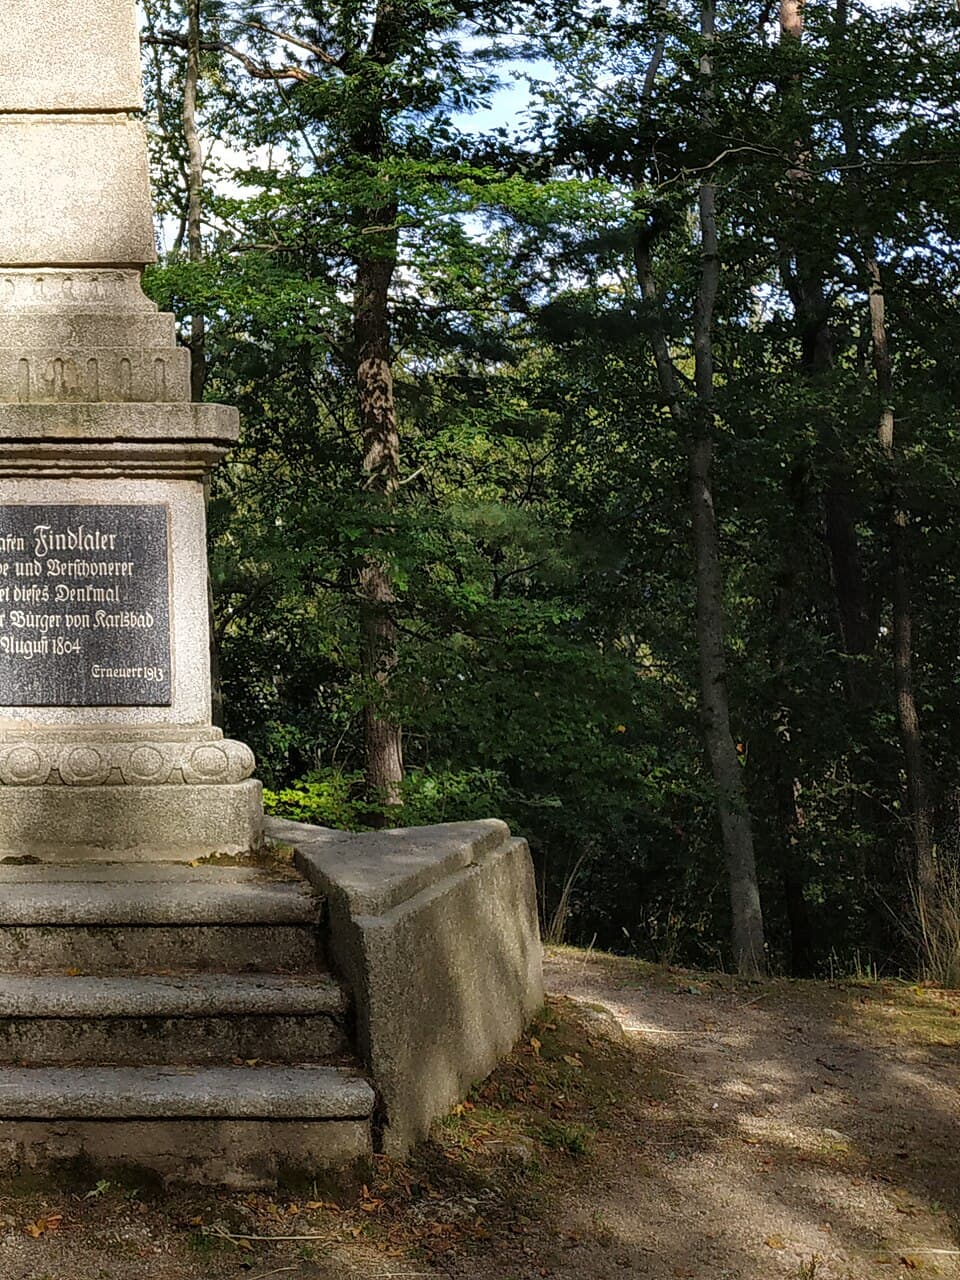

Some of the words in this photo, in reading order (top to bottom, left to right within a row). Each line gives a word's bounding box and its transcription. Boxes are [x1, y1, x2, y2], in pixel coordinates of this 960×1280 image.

[33, 525, 117, 557] Findlater
[15, 559, 42, 576] und
[13, 585, 49, 604] dieses
[54, 584, 120, 602] Denkmal
[65, 612, 90, 628] von
[93, 609, 154, 628] Karlsbad
[0, 636, 49, 659] August
[51, 636, 82, 655] 1804
[91, 665, 141, 679] Erneuert
[142, 666, 164, 682] 1913
